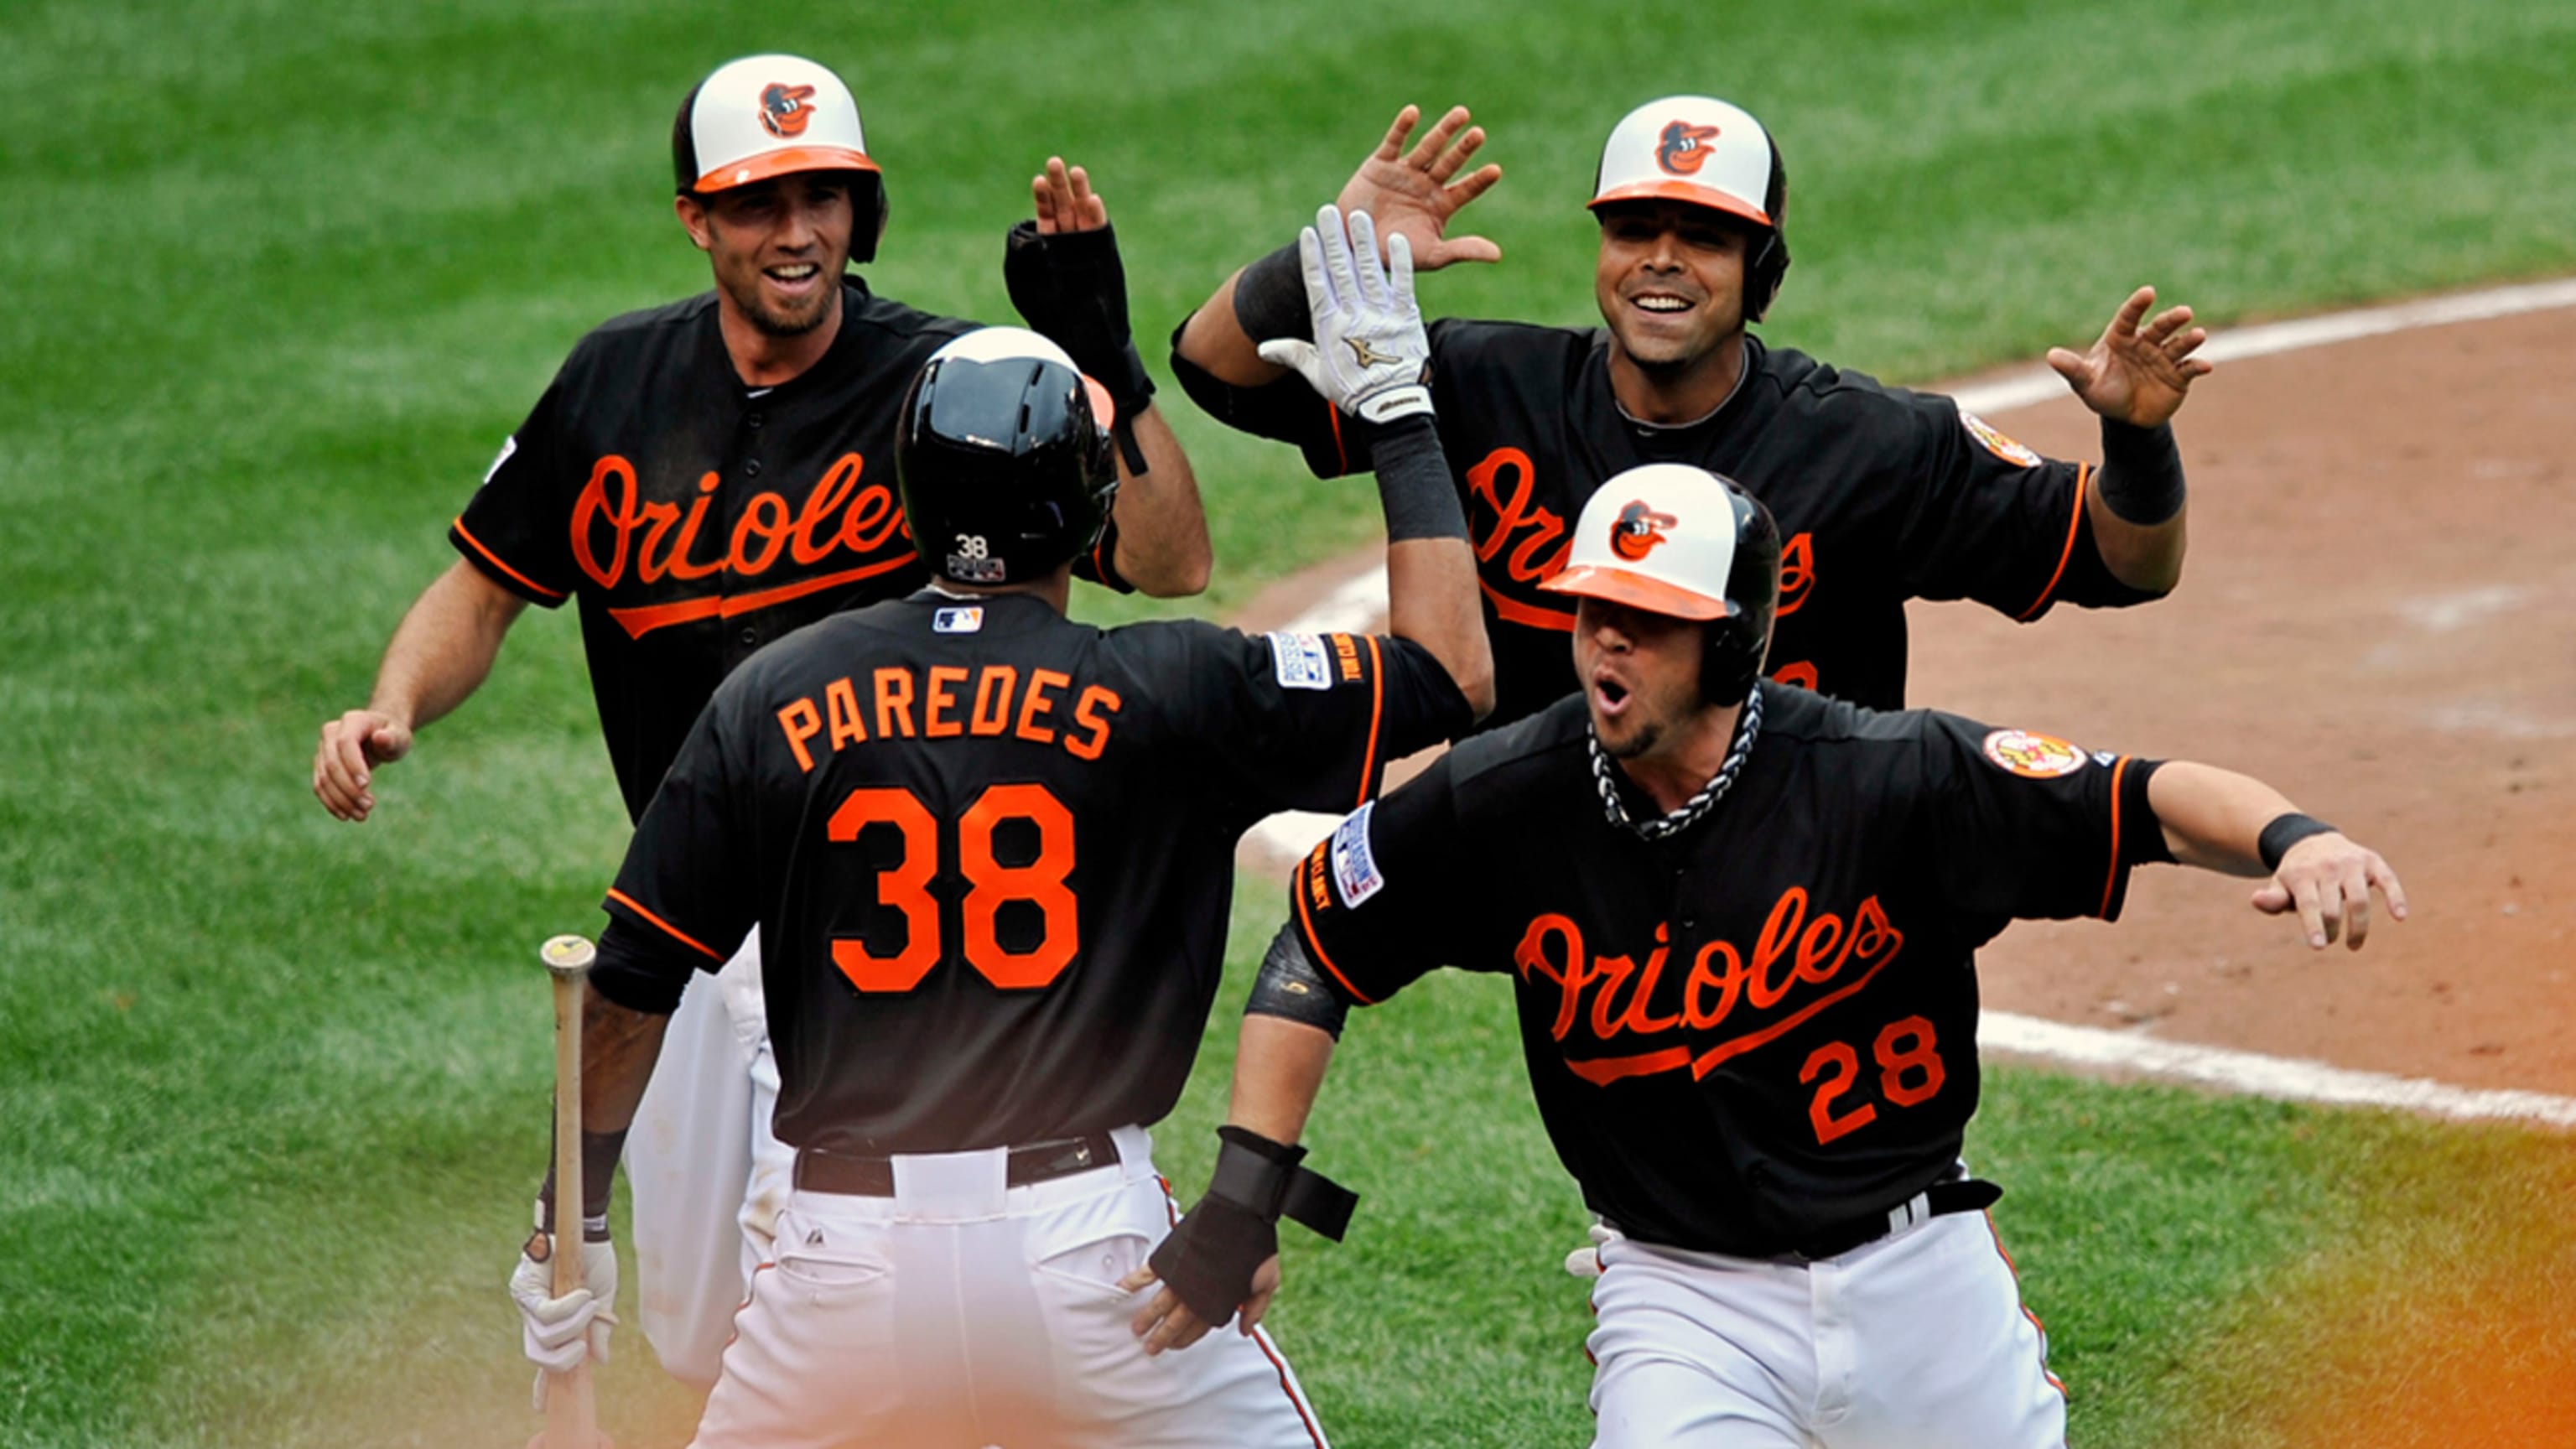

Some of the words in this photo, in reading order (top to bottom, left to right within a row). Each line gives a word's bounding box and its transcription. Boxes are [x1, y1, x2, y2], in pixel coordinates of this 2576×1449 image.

[571, 452, 912, 591] Oriole
[955, 533, 989, 559] 38
[776, 664, 1122, 773] PAREDES
[826, 783, 1080, 993] 38
[1514, 885, 1903, 1041] Orioles
[1798, 1014, 1946, 1146] 28
